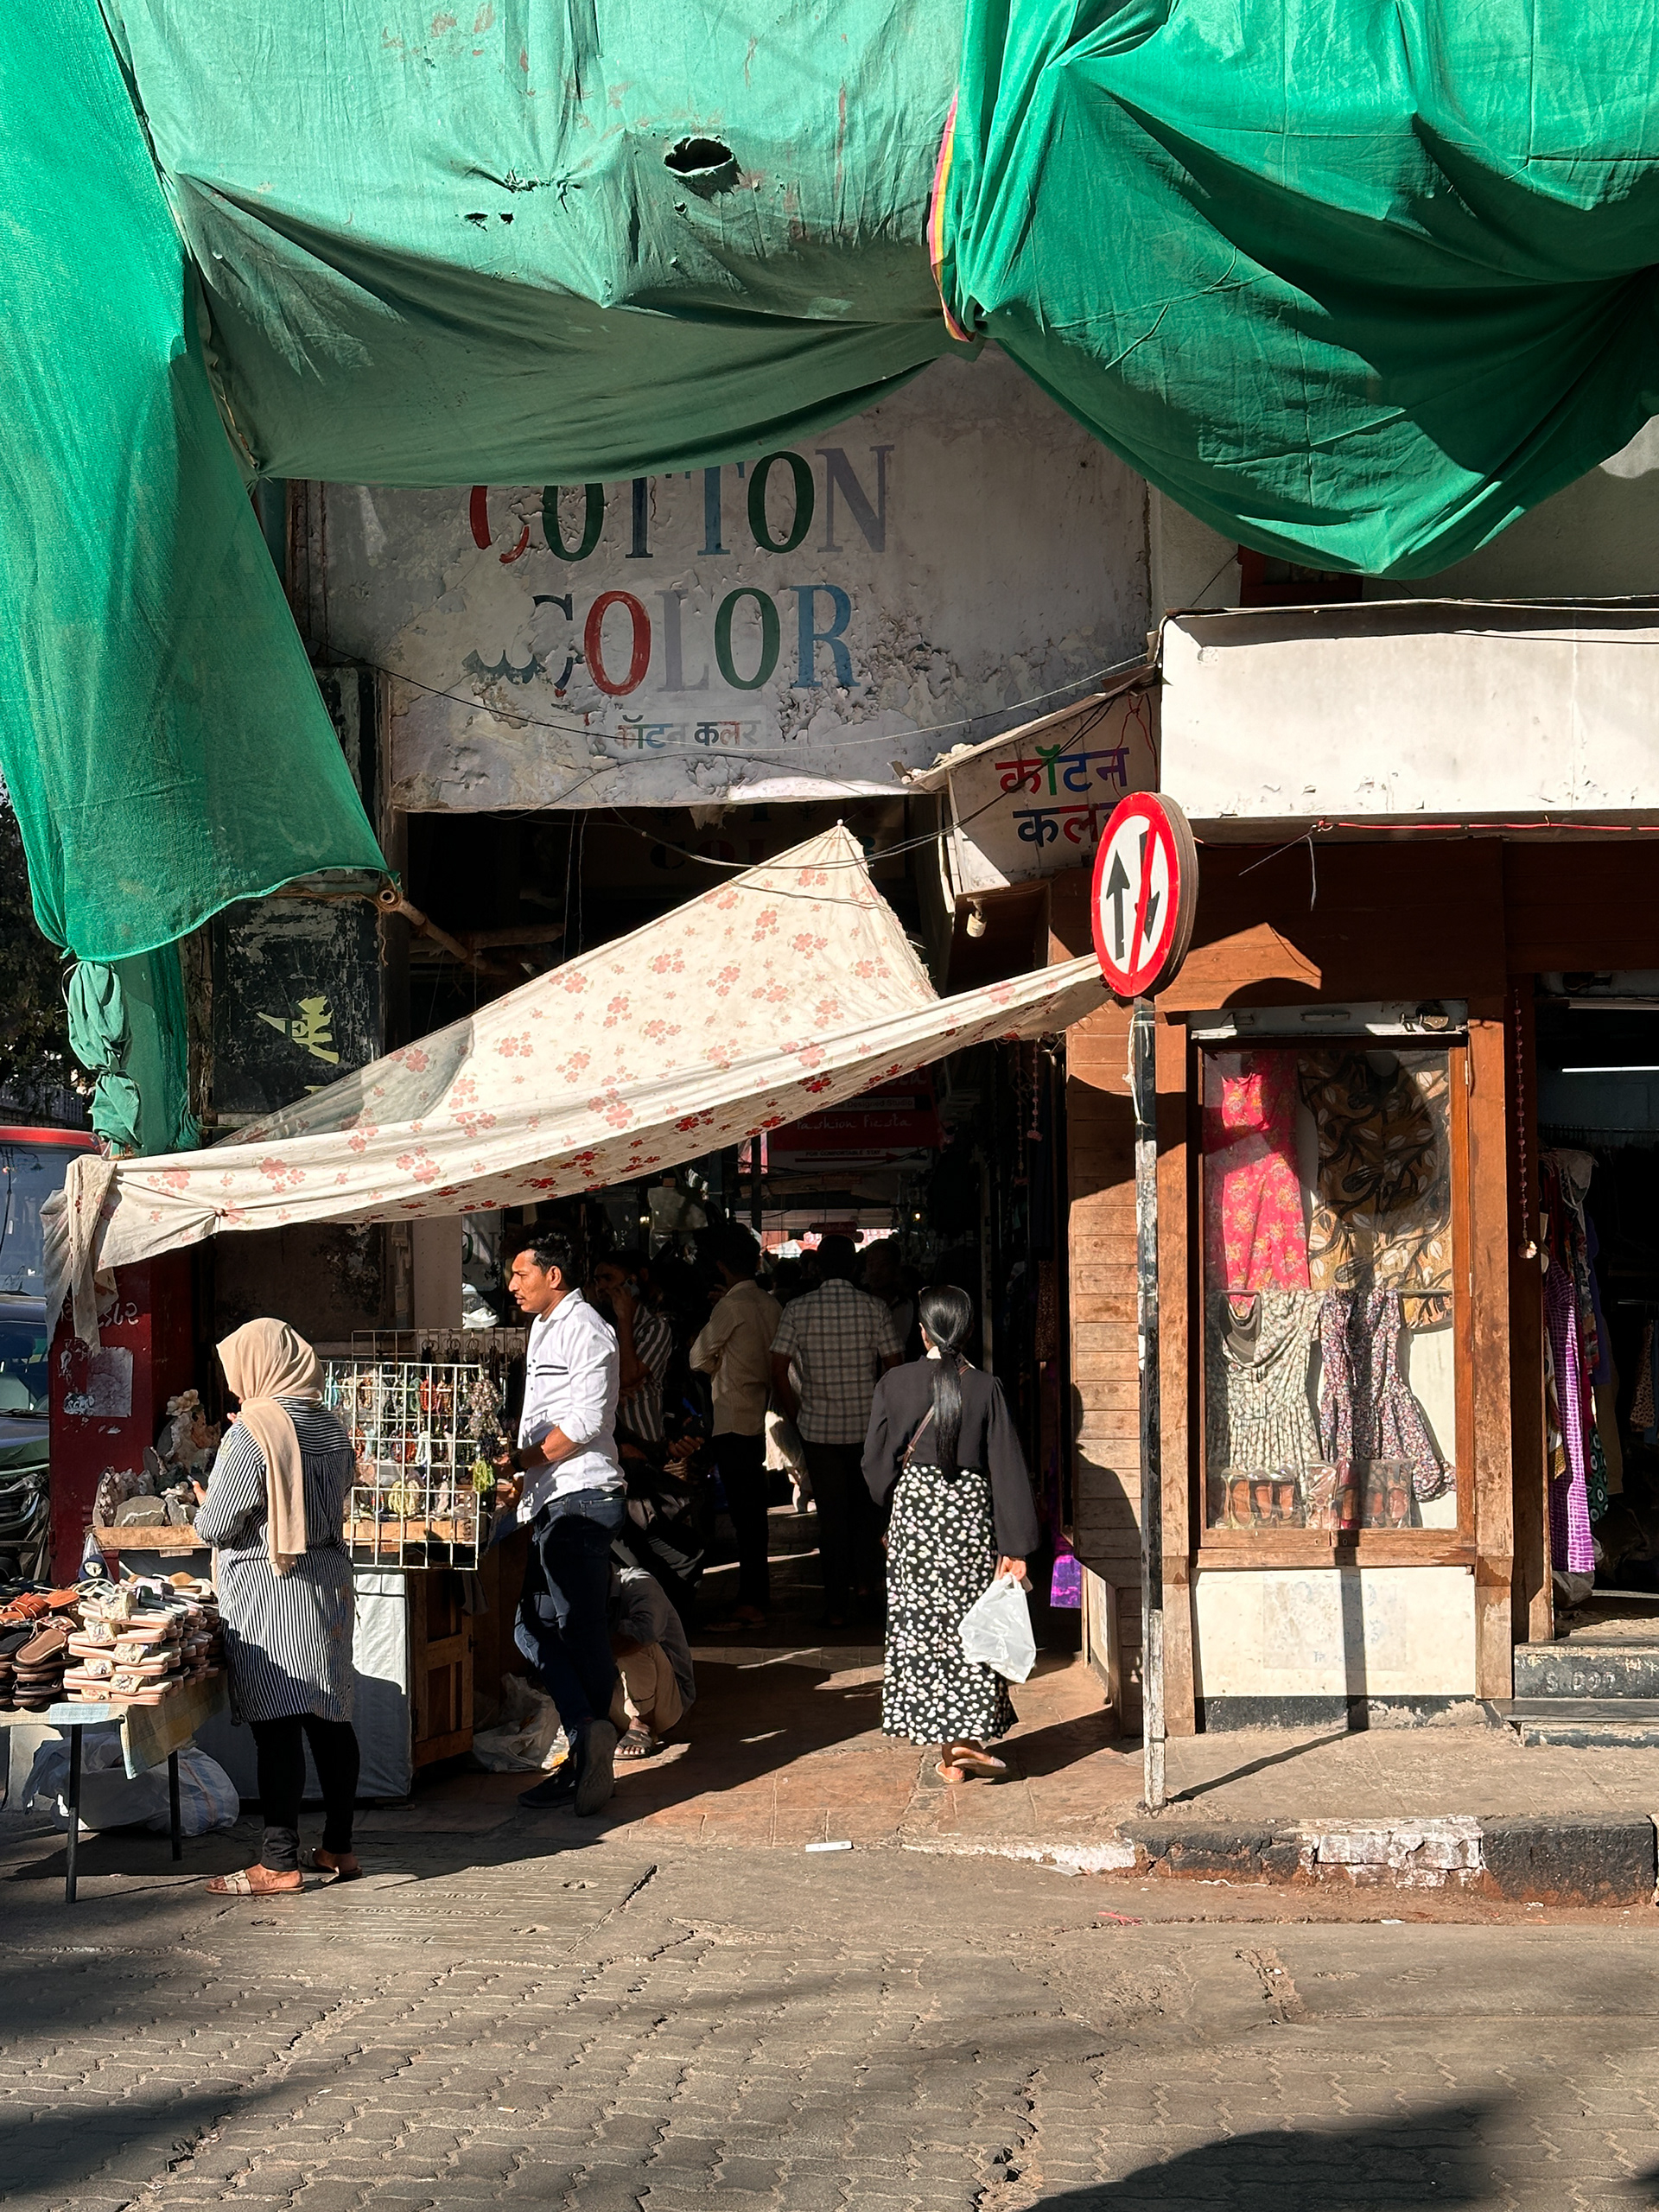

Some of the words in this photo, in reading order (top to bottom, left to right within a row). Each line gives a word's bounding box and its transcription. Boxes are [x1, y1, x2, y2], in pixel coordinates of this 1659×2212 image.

[694, 720, 761, 746] कलर
[995, 744, 1129, 796] कॉटन
[1013, 802, 1119, 848] कल
